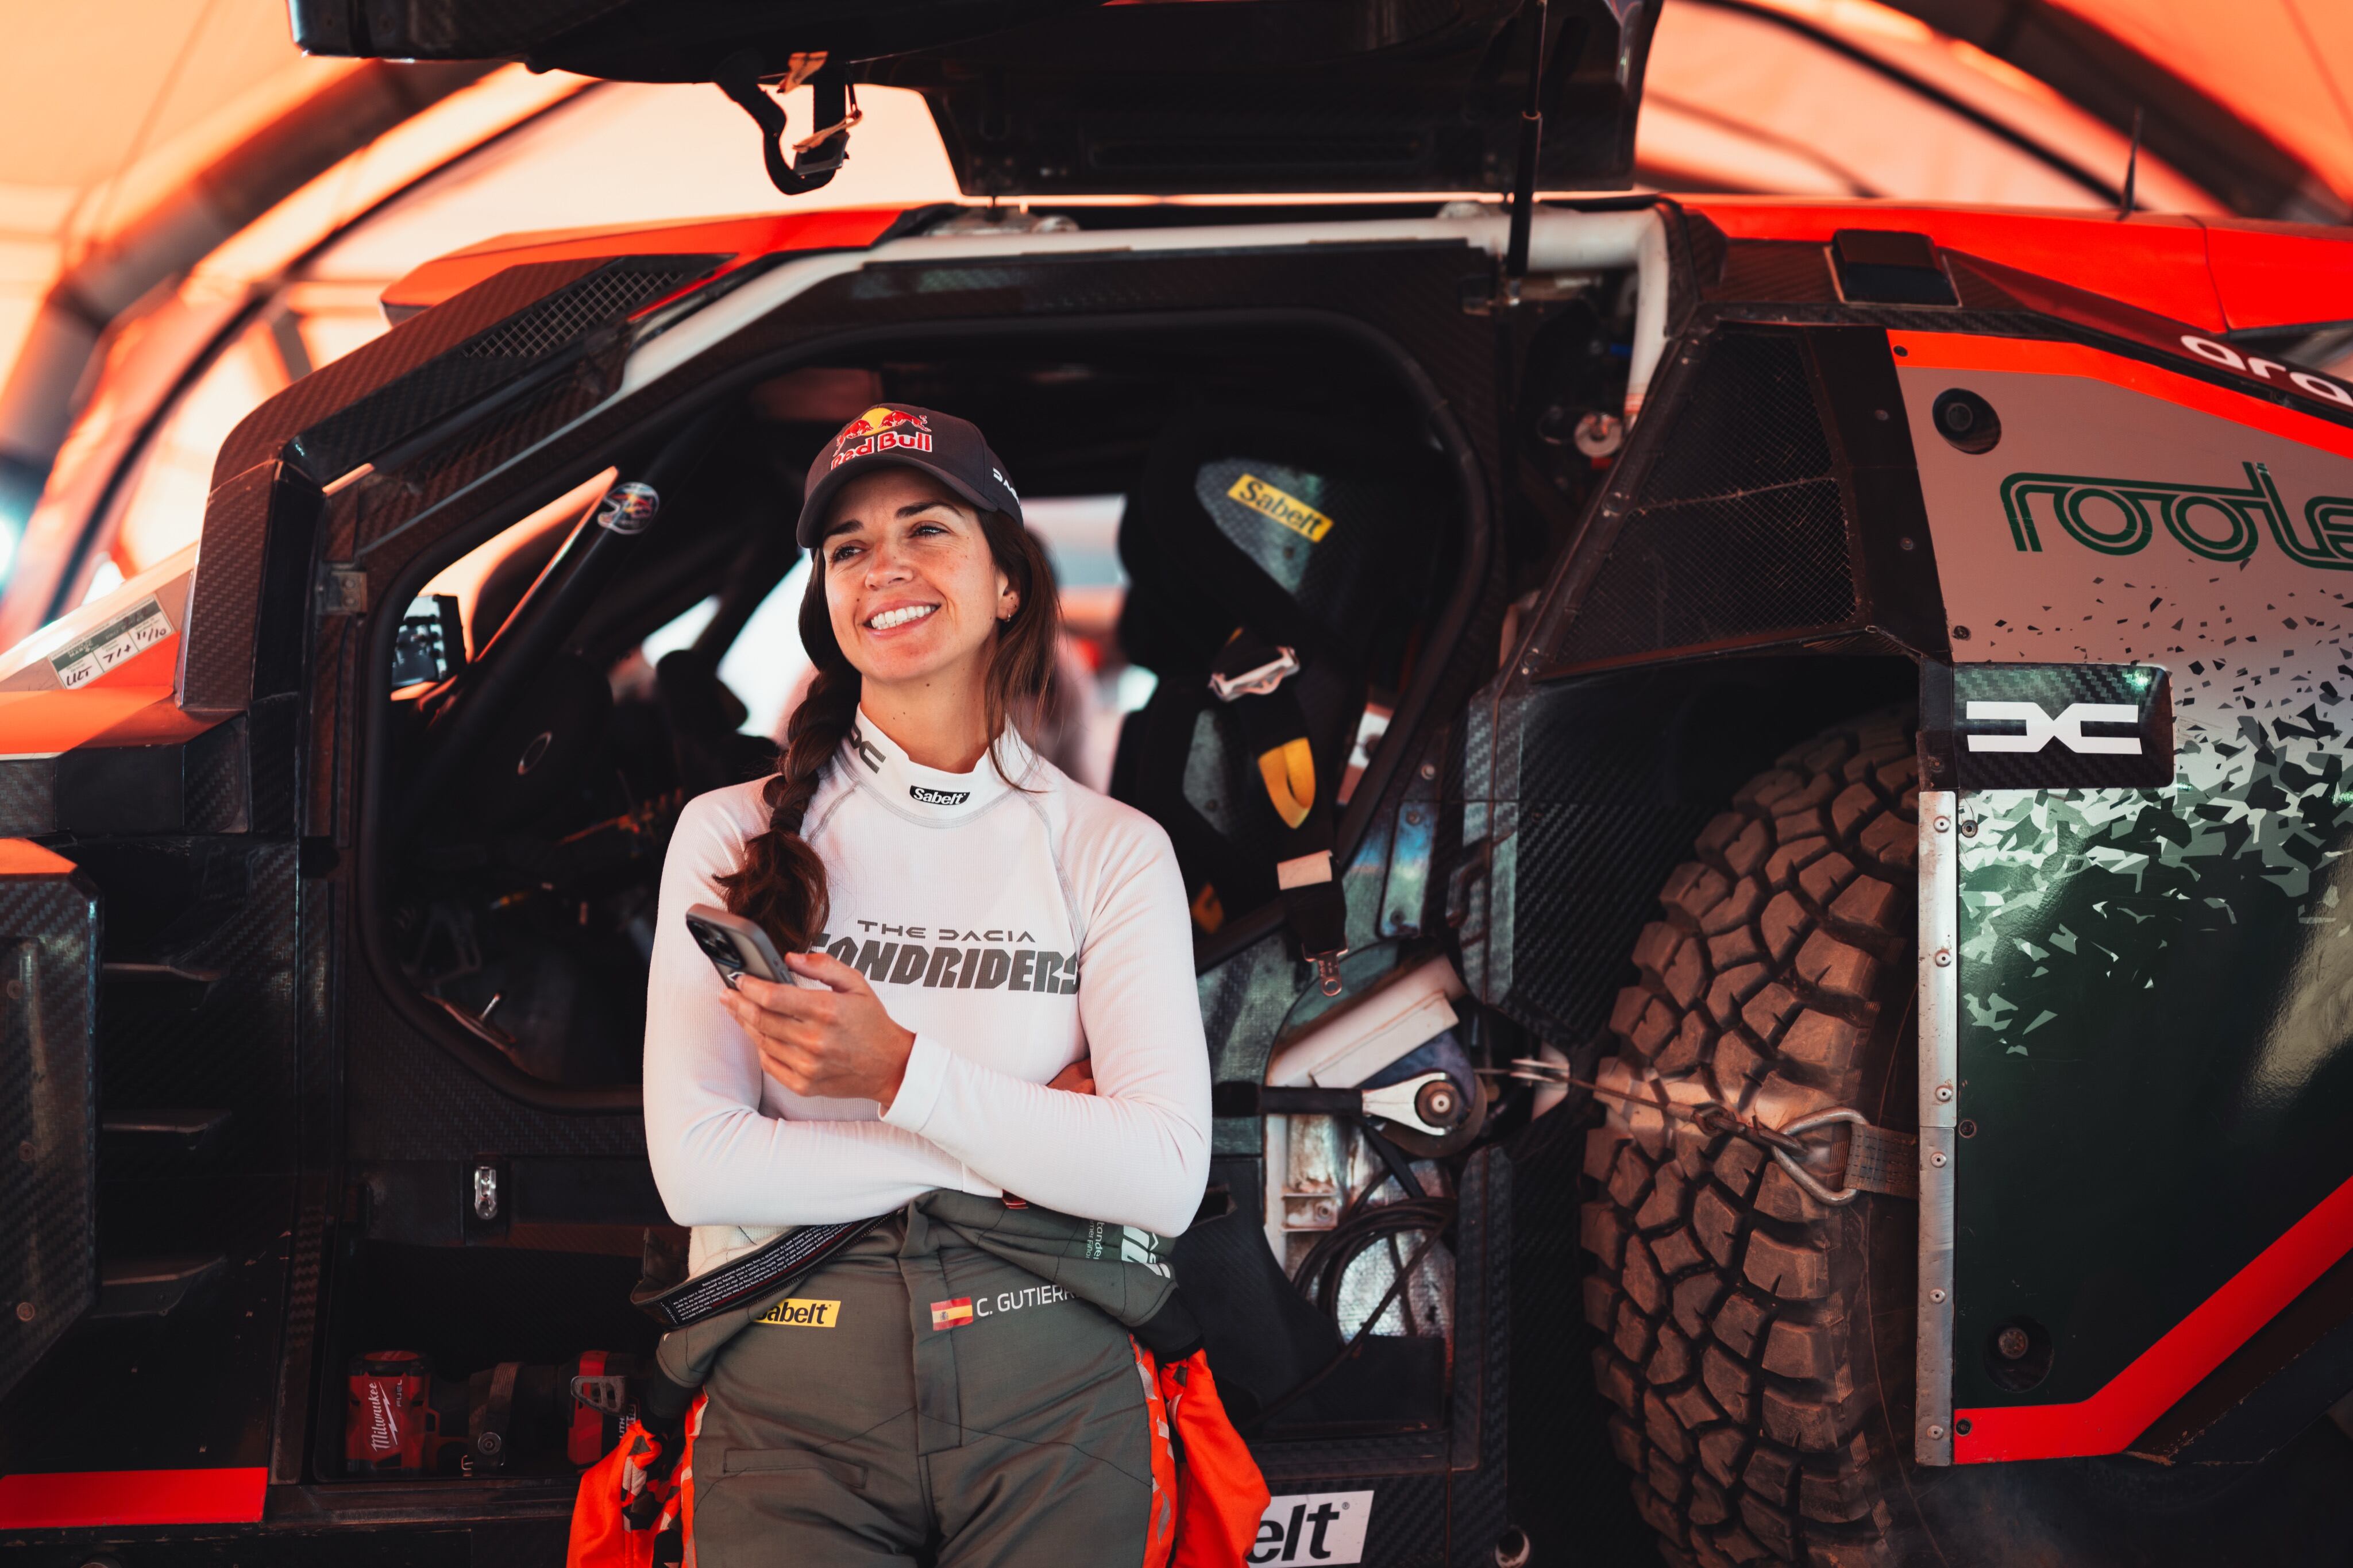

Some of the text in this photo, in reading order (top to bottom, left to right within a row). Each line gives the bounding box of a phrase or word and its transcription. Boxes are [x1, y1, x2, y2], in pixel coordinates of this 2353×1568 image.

[831, 431, 932, 470] Red Bull
[1239, 481, 1322, 535] Sabelt
[913, 788, 964, 805] Sabelt
[857, 920, 1036, 944] THE DACIA
[977, 1297, 993, 1317] C.
[369, 1382, 390, 1452] Milwaukee
[1245, 1502, 1340, 1564] elt
